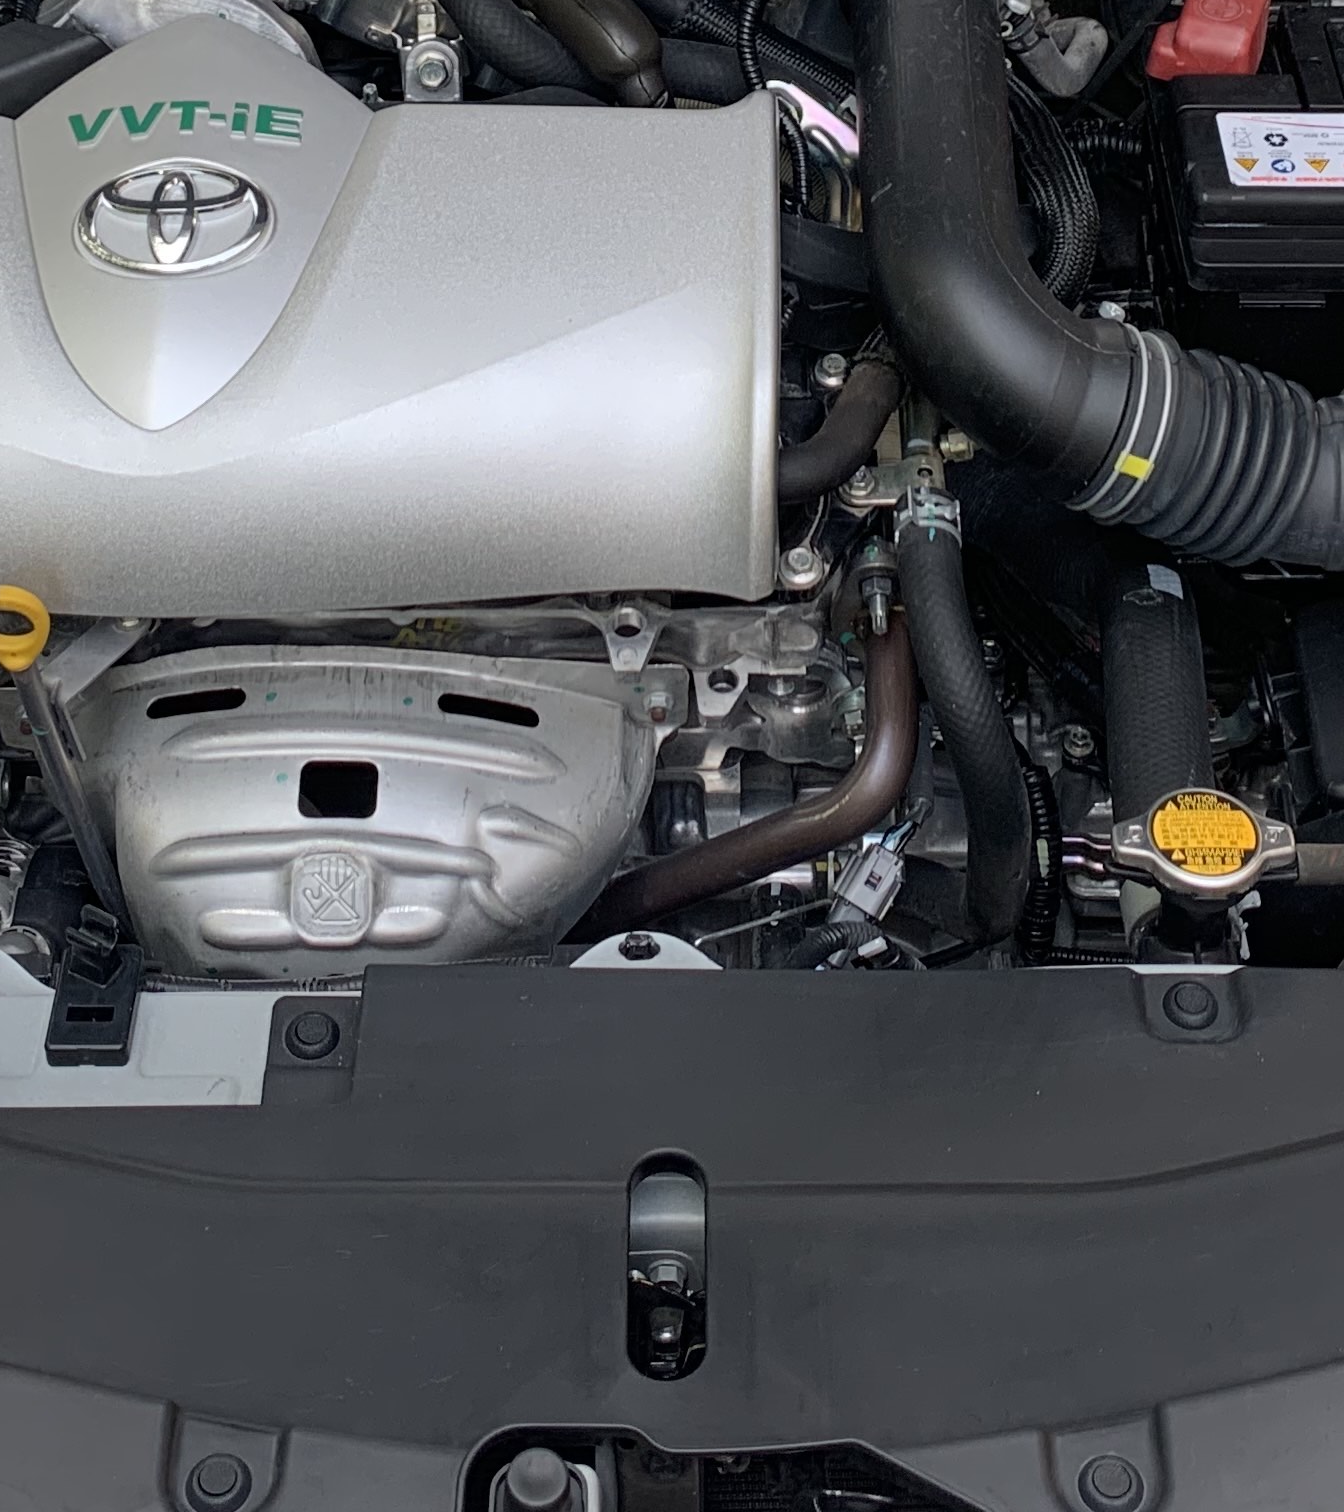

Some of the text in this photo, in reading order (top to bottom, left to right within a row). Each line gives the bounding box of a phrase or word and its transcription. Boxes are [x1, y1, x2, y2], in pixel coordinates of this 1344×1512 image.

[68, 100, 305, 148] VVT-iE
[1176, 794, 1218, 804] CAUTION
[1179, 802, 1231, 811] ATTENTION
